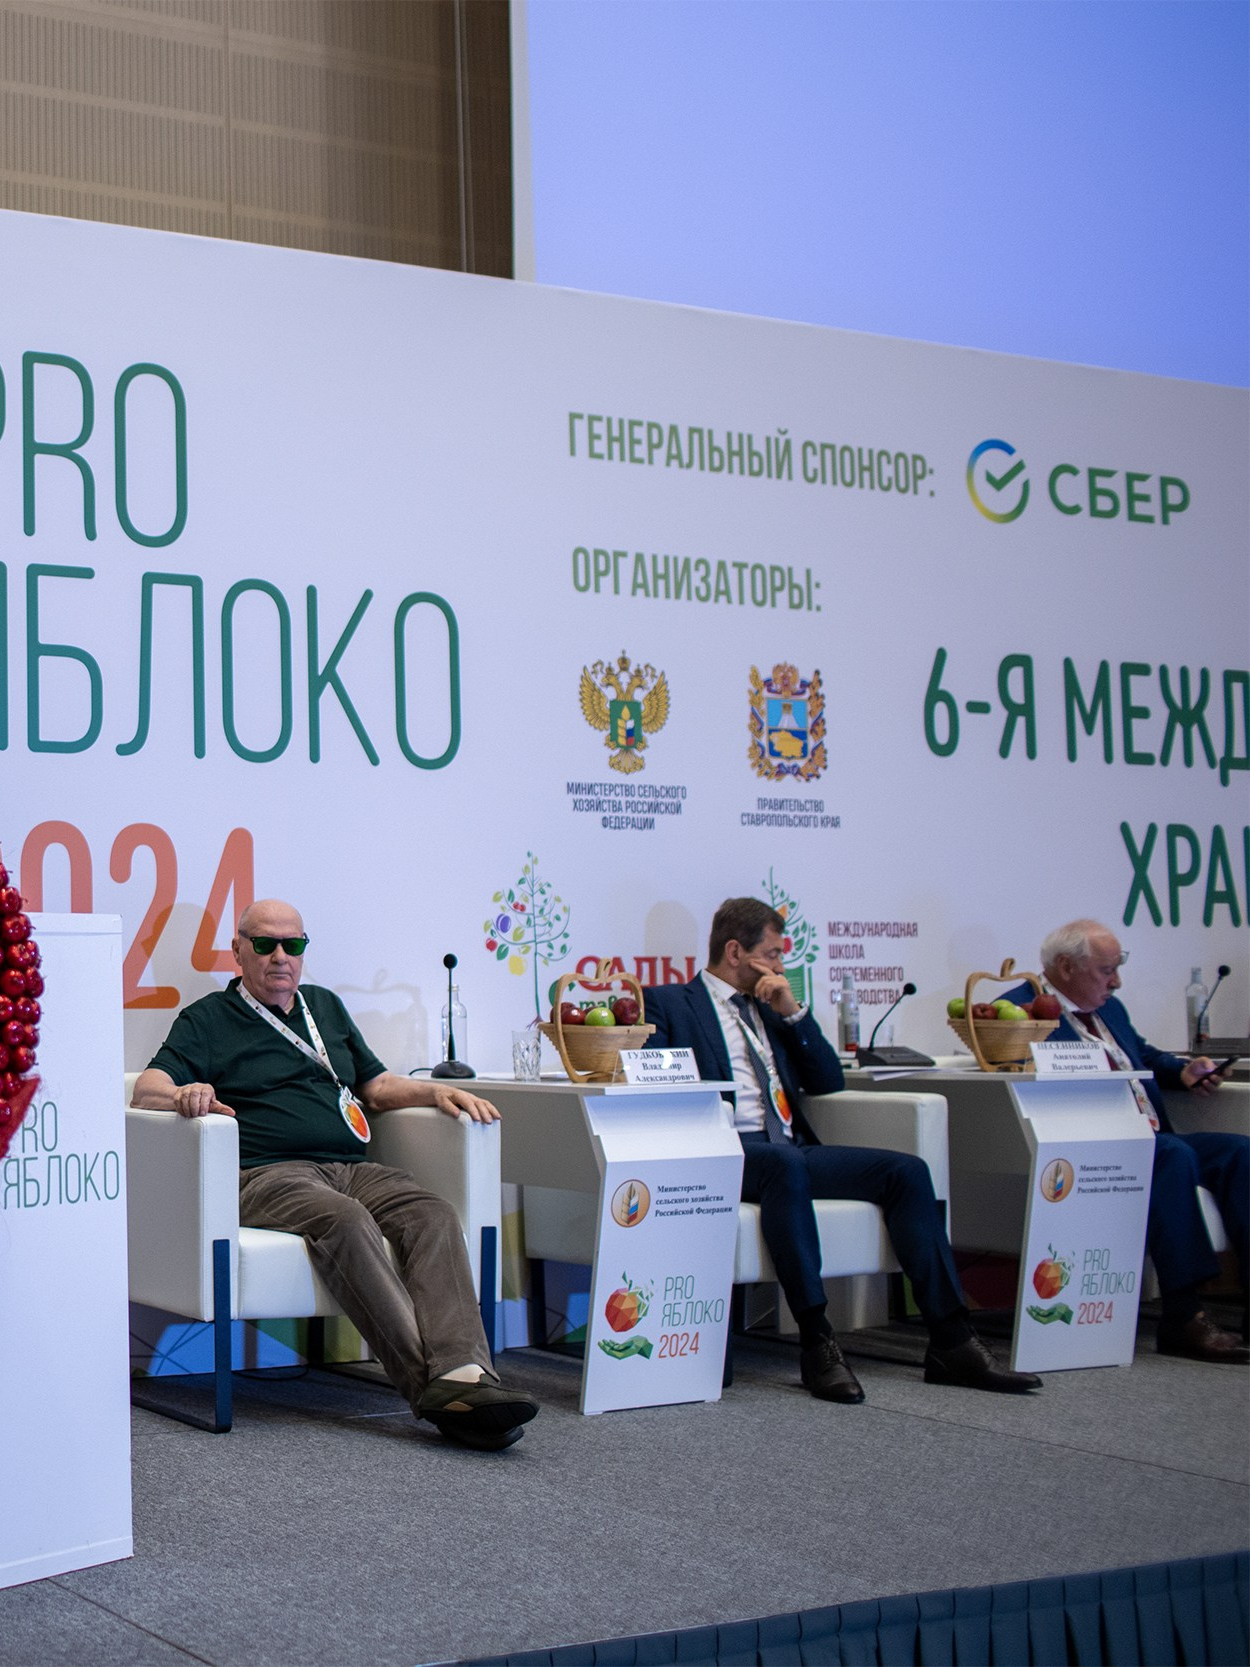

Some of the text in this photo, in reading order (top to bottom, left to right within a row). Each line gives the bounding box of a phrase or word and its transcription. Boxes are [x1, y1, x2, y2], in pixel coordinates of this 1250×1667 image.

[568, 411, 935, 497] ГЕНЕРАЛЬНЫЙ СПОНСОР:
[1048, 463, 1191, 526] СБЕР
[572, 546, 822, 612] ОРГАНИЗАТОРЫ:
[923, 646, 1037, 761] 6-Я
[566, 782, 687, 799] МИНИСТЕРСТВО СЕЛЬСКОГО
[572, 798, 682, 815] ХОЗЯЙСТВА РОССИЙСКОЙ
[757, 797, 825, 813] ПРАВИТЕЛЬСТВО
[601, 816, 655, 831] ФЕДЕРАЦИИ
[740, 812, 841, 829] СТАВРОПОЛЬСКОГО КРАЯ
[1119, 821, 1250, 928] ХРА
[828, 921, 918, 938] МЕЖДУНАРОДНАЯ
[828, 944, 865, 960] ШКОЛА
[829, 966, 904, 982] СОЕМЕННОГО
[830, 988, 901, 1005] СВОДСТВА
[635, 1073, 695, 1083] Александрович
[21, 1101, 58, 1154] RO
[1079, 1164, 1122, 1172] Министерство
[3, 1150, 120, 1210] ЯБЛОКО
[656, 1184, 707, 1193] Министерство
[655, 1195, 724, 1205] сельского хозяйства
[654, 1206, 733, 1217] Российской Федерации
[1083, 1248, 1110, 1272] PRO
[663, 1274, 695, 1301] PRO
[1080, 1271, 1136, 1296] ЯБЛОКО
[661, 1298, 725, 1327] ЯБЛОКО
[1077, 1301, 1113, 1325] 2024
[658, 1331, 699, 1359] 2024
